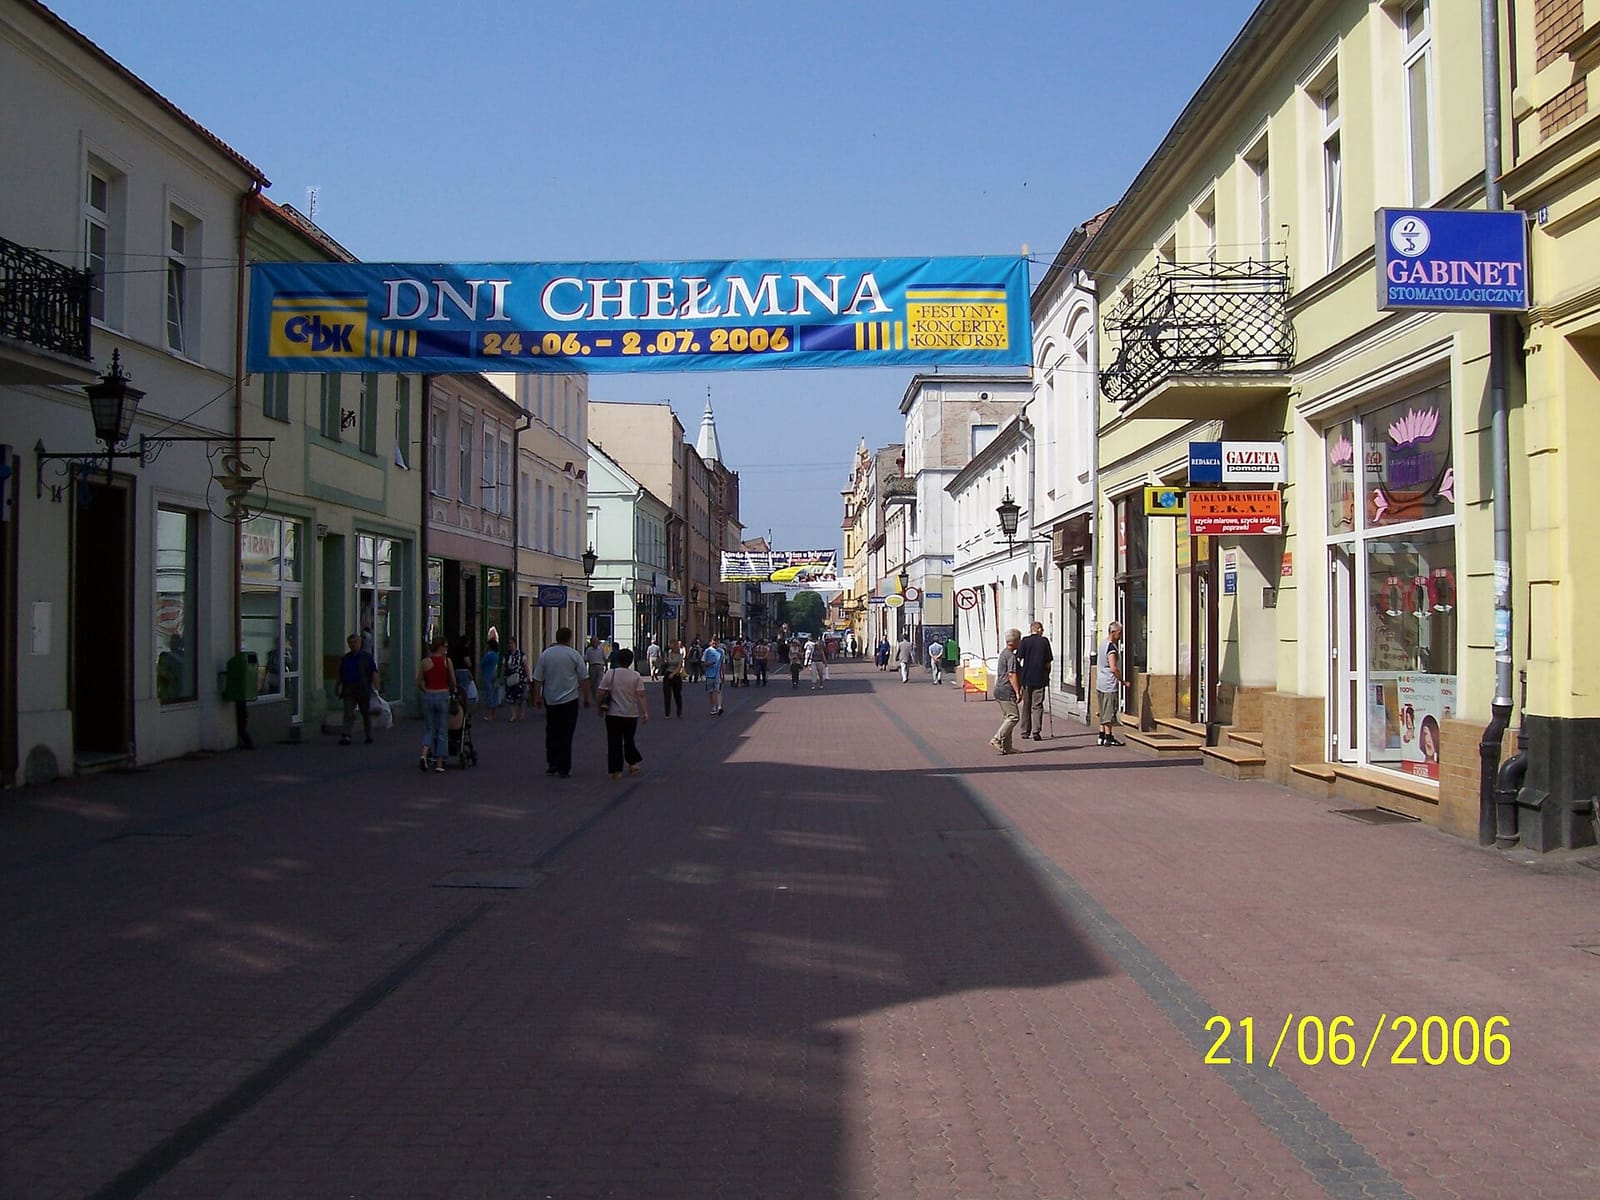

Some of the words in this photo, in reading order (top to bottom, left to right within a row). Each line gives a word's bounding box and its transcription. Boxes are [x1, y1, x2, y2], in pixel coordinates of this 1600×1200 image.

[1387, 260, 1522, 286] GABINET
[381, 278, 512, 321] DNI
[540, 272, 893, 322] CHEŁMNA
[1388, 287, 1524, 303] STOMATOLOGICZNY
[921, 305, 995, 318] FESTYNY
[916, 320, 1002, 333] KONCERTY
[709, 327, 790, 352] 2006
[914, 333, 1003, 347] KONKURSY
[1191, 458, 1221, 466] REDAKCJA
[1226, 451, 1279, 465] GAZETA
[1228, 465, 1279, 473] pomorska
[1228, 493, 1277, 502] KRAWIECKI
